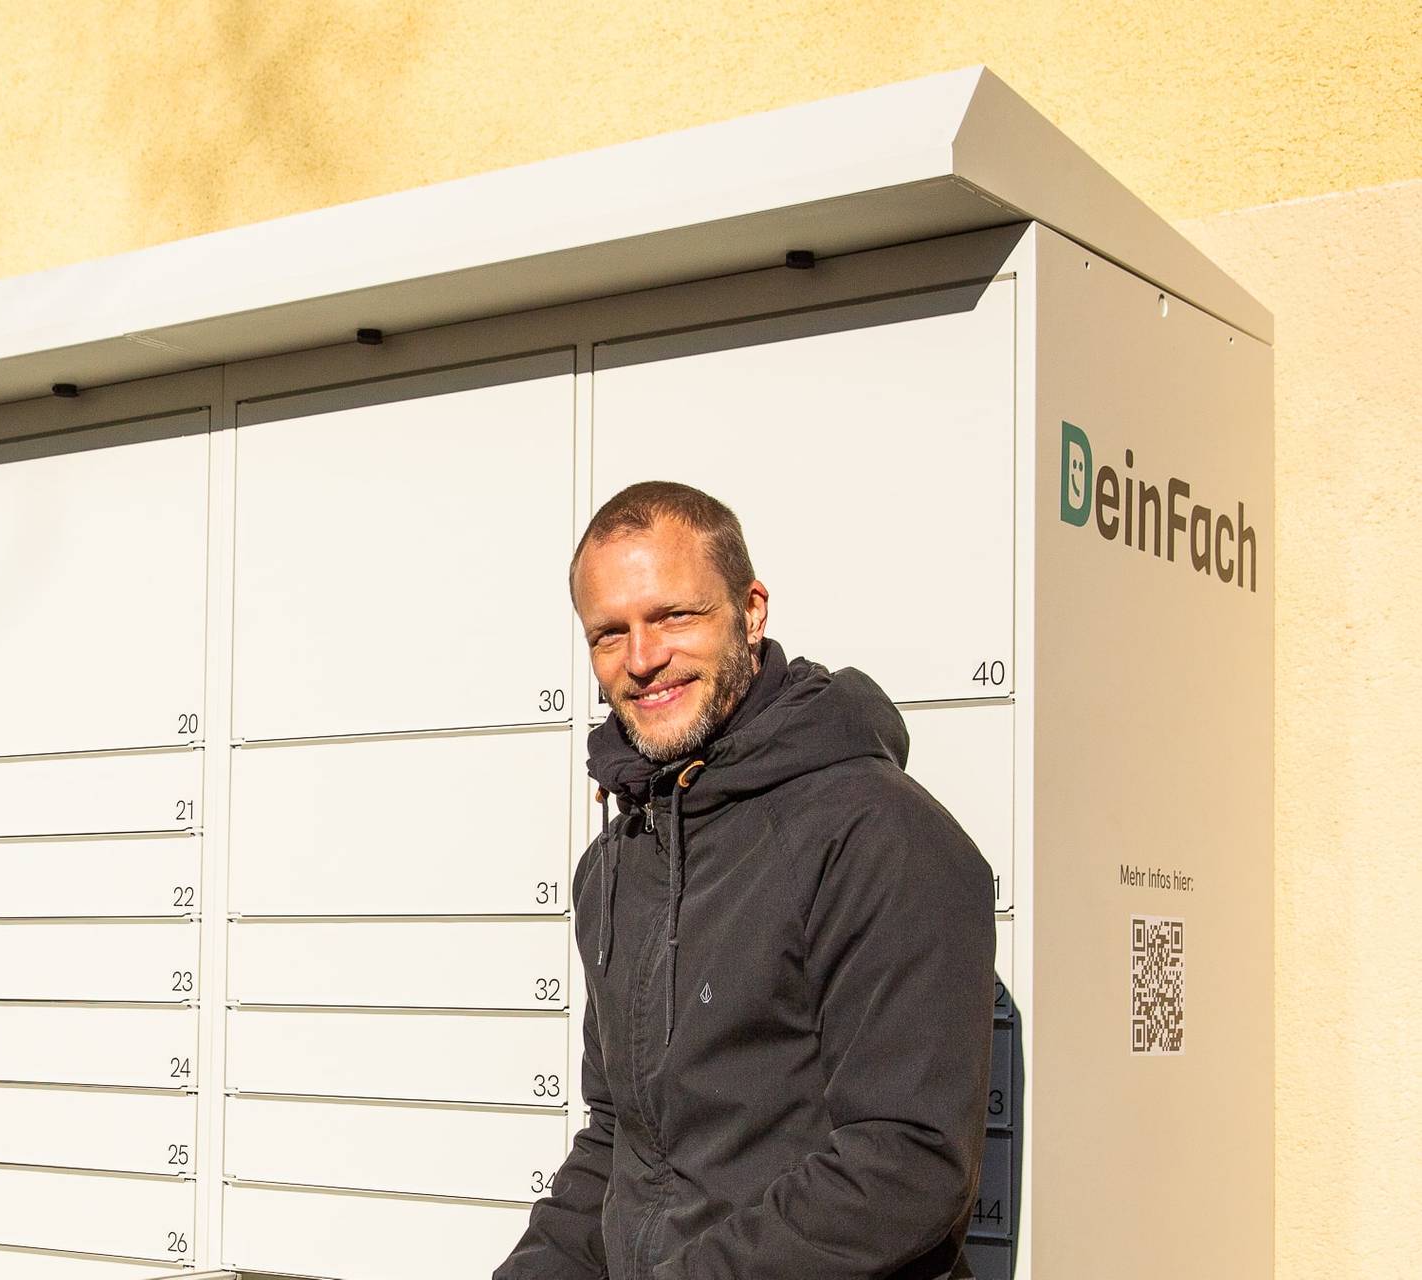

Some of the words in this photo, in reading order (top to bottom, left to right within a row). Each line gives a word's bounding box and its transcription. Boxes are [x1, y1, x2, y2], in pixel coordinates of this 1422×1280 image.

[1061, 421, 1256, 592] DeinFach
[972, 661, 1004, 685] 40
[539, 689, 564, 712] 30
[178, 714, 198, 734] 20
[176, 800, 193, 820] 21
[993, 875, 1000, 900] 1
[1121, 864, 1145, 886] Mehr
[1149, 868, 1171, 889] Infos
[1174, 871, 1193, 891] hier:
[174, 887, 193, 906] 22
[536, 882, 557, 904] 31
[172, 971, 193, 991] 23
[535, 978, 560, 1001] 32
[994, 982, 1006, 1007] 2
[171, 1058, 190, 1077] 24
[533, 1075, 559, 1097] 33
[987, 1089, 1004, 1115] 3
[168, 1144, 188, 1165] 25
[168, 1232, 187, 1252] 26
